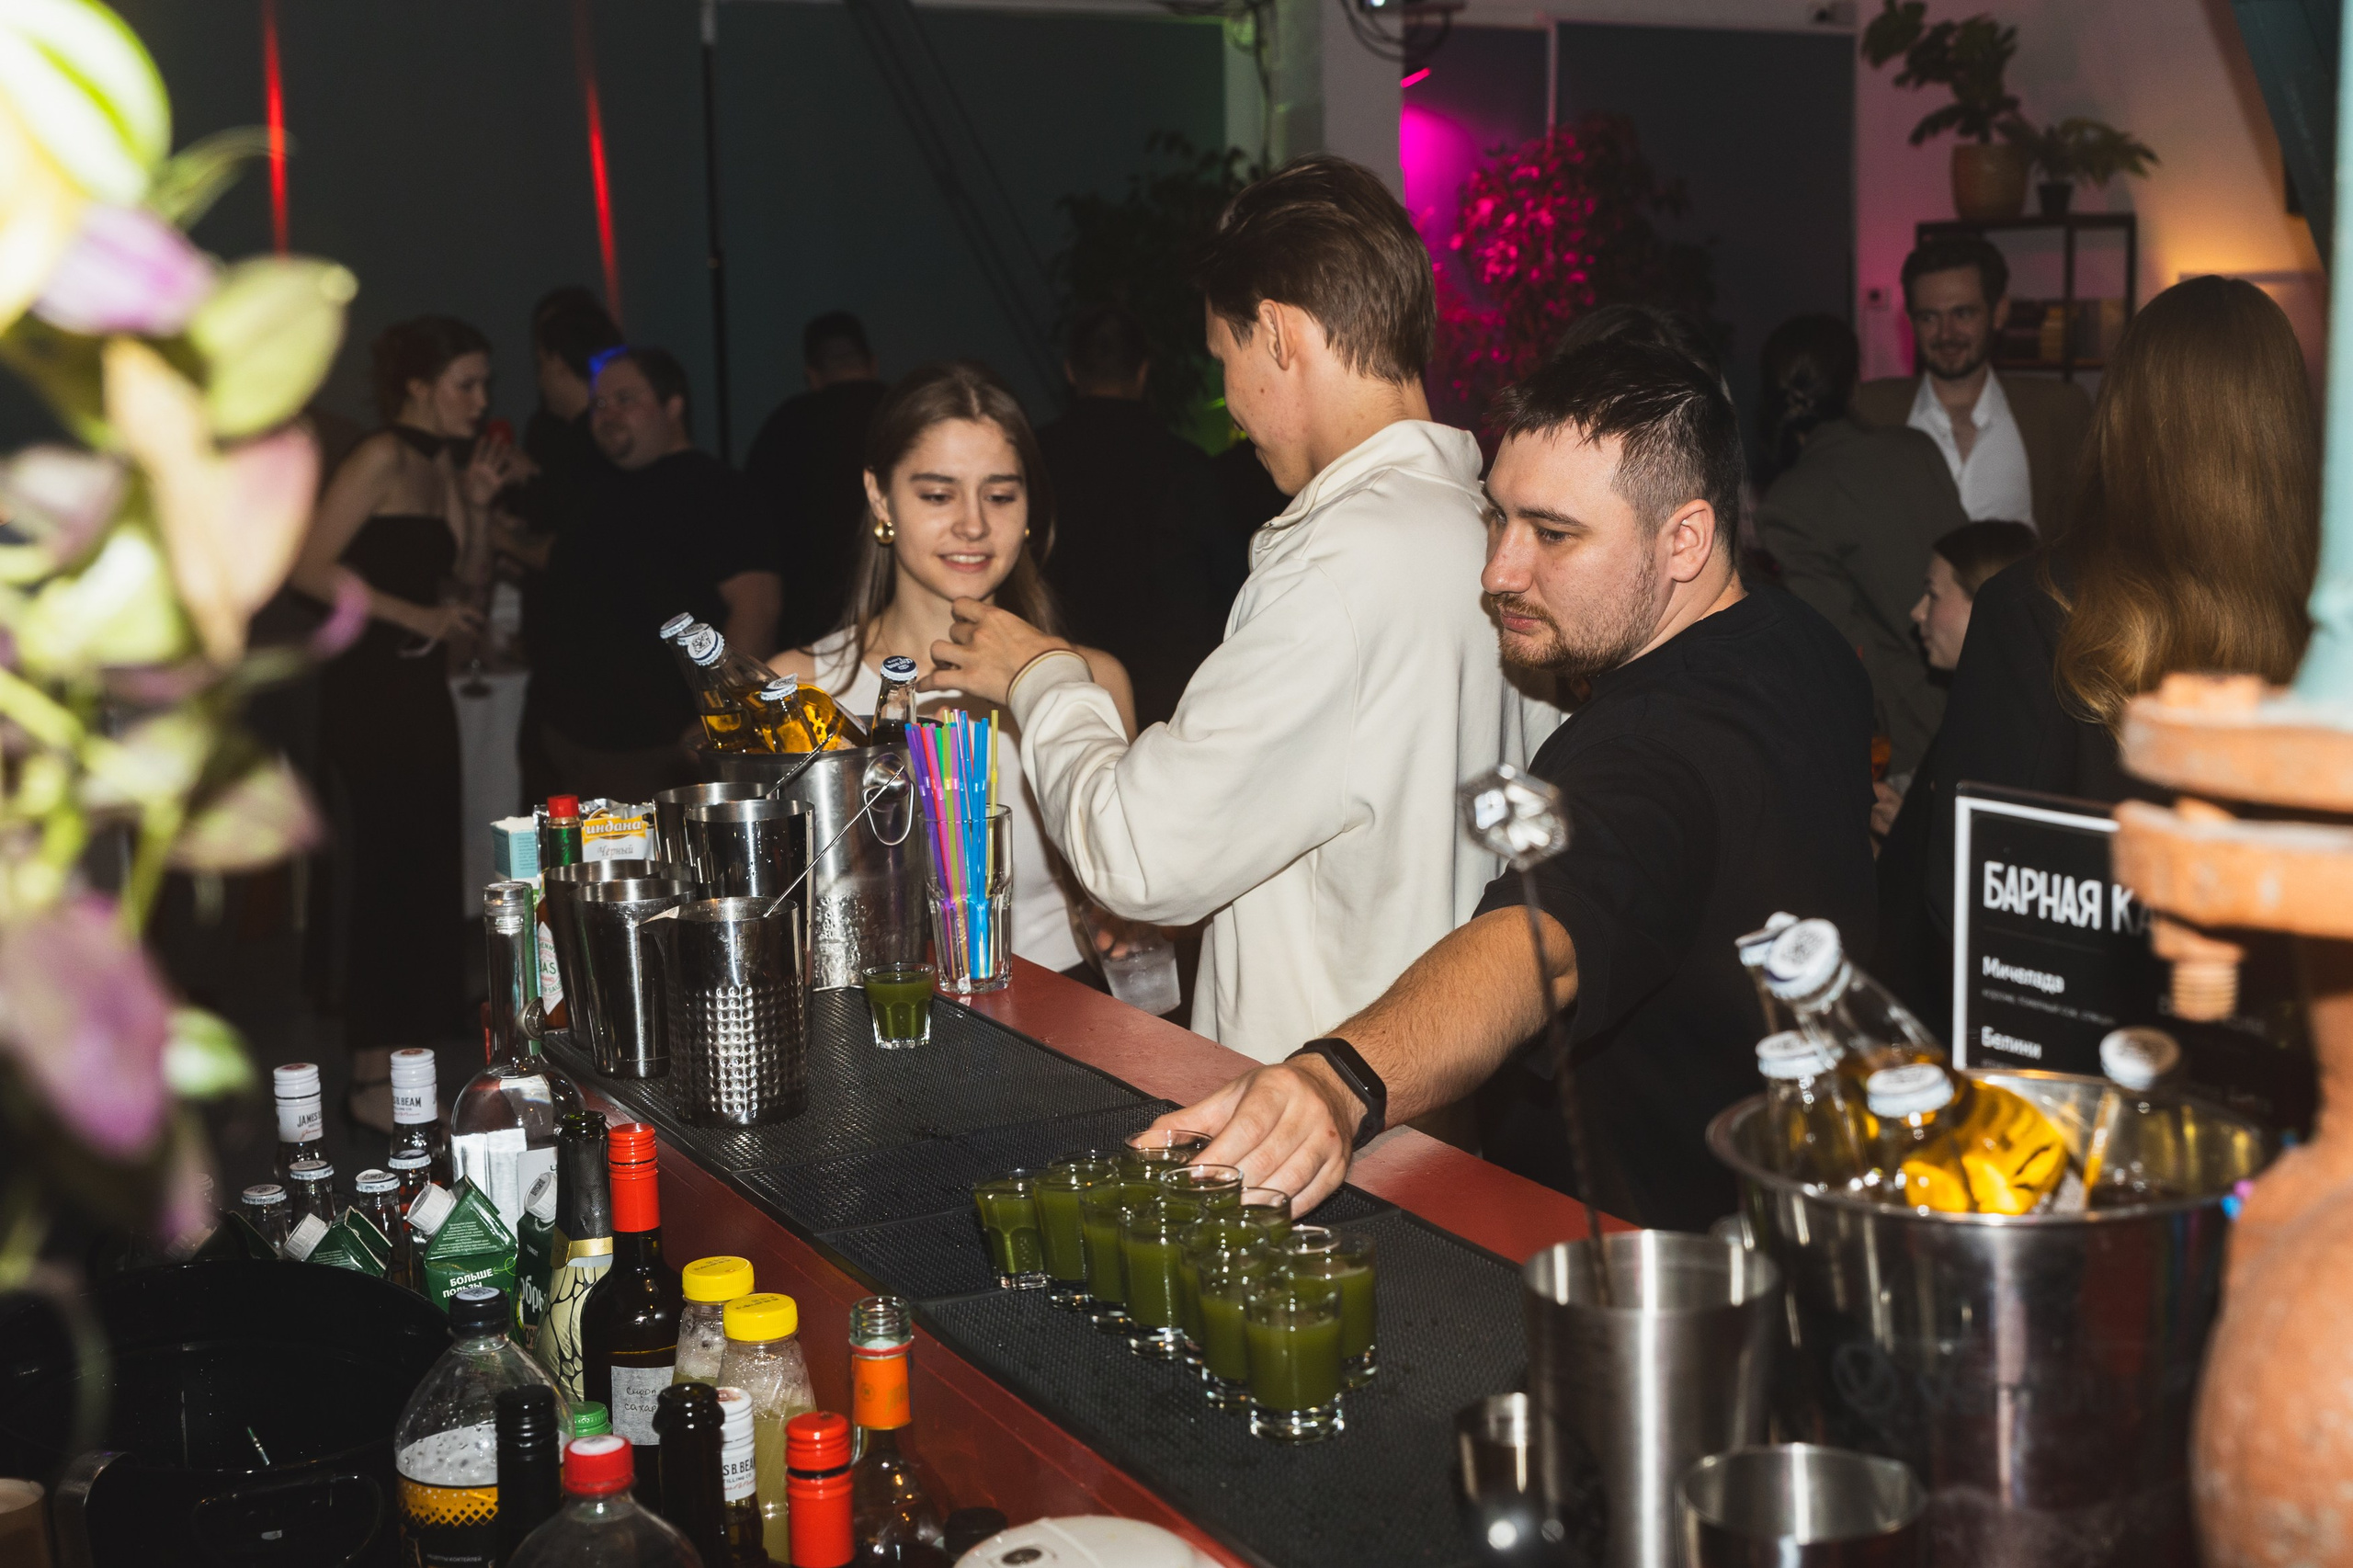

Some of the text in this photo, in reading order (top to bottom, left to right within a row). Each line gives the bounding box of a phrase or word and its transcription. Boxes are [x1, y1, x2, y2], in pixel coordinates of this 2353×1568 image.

[1983, 859, 2145, 936] БАРНАЯ К
[400, 1096, 422, 1108] BEAM
[296, 1111, 318, 1128] JAMES
[449, 1267, 494, 1288] БОЛЬШЕ
